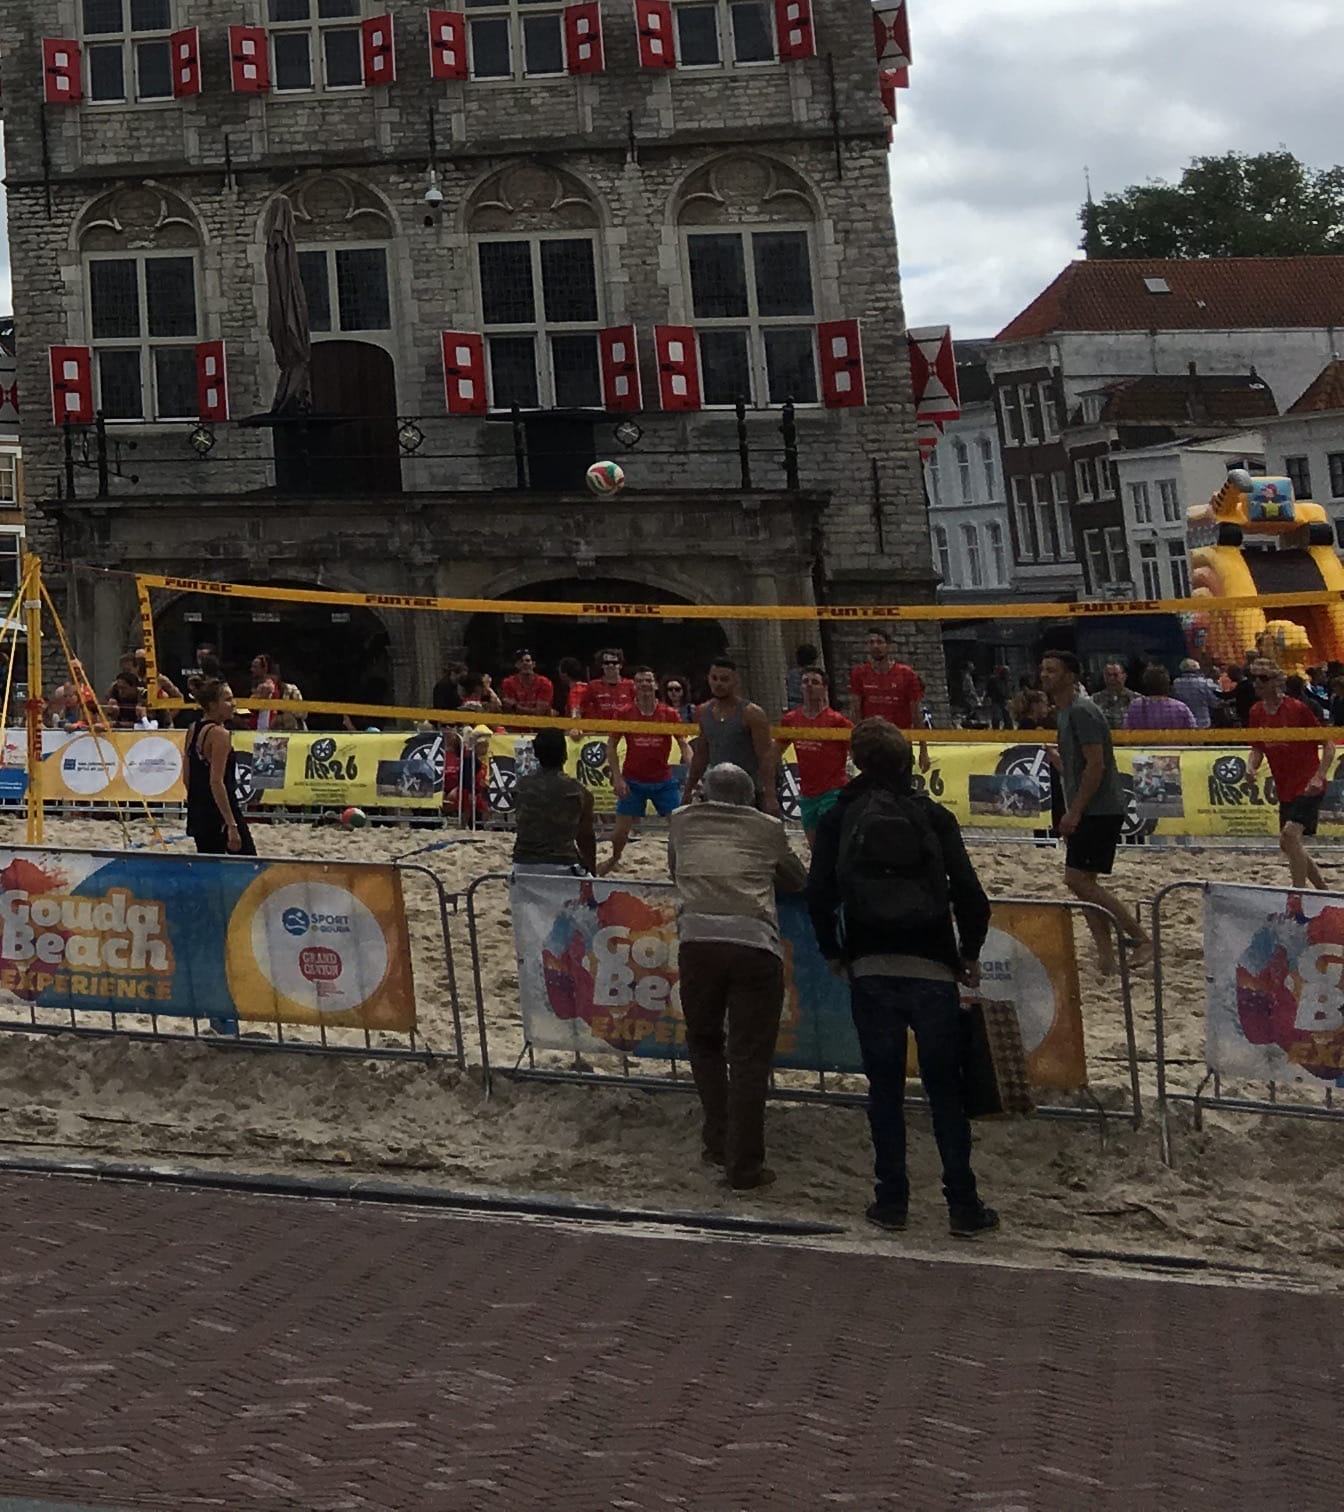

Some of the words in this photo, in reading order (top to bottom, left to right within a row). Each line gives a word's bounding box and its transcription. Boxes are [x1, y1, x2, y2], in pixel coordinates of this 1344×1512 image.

[0, 889, 162, 935] Gouda
[1, 921, 169, 971] Beach
[0, 968, 172, 1001] EXPERIENCE
